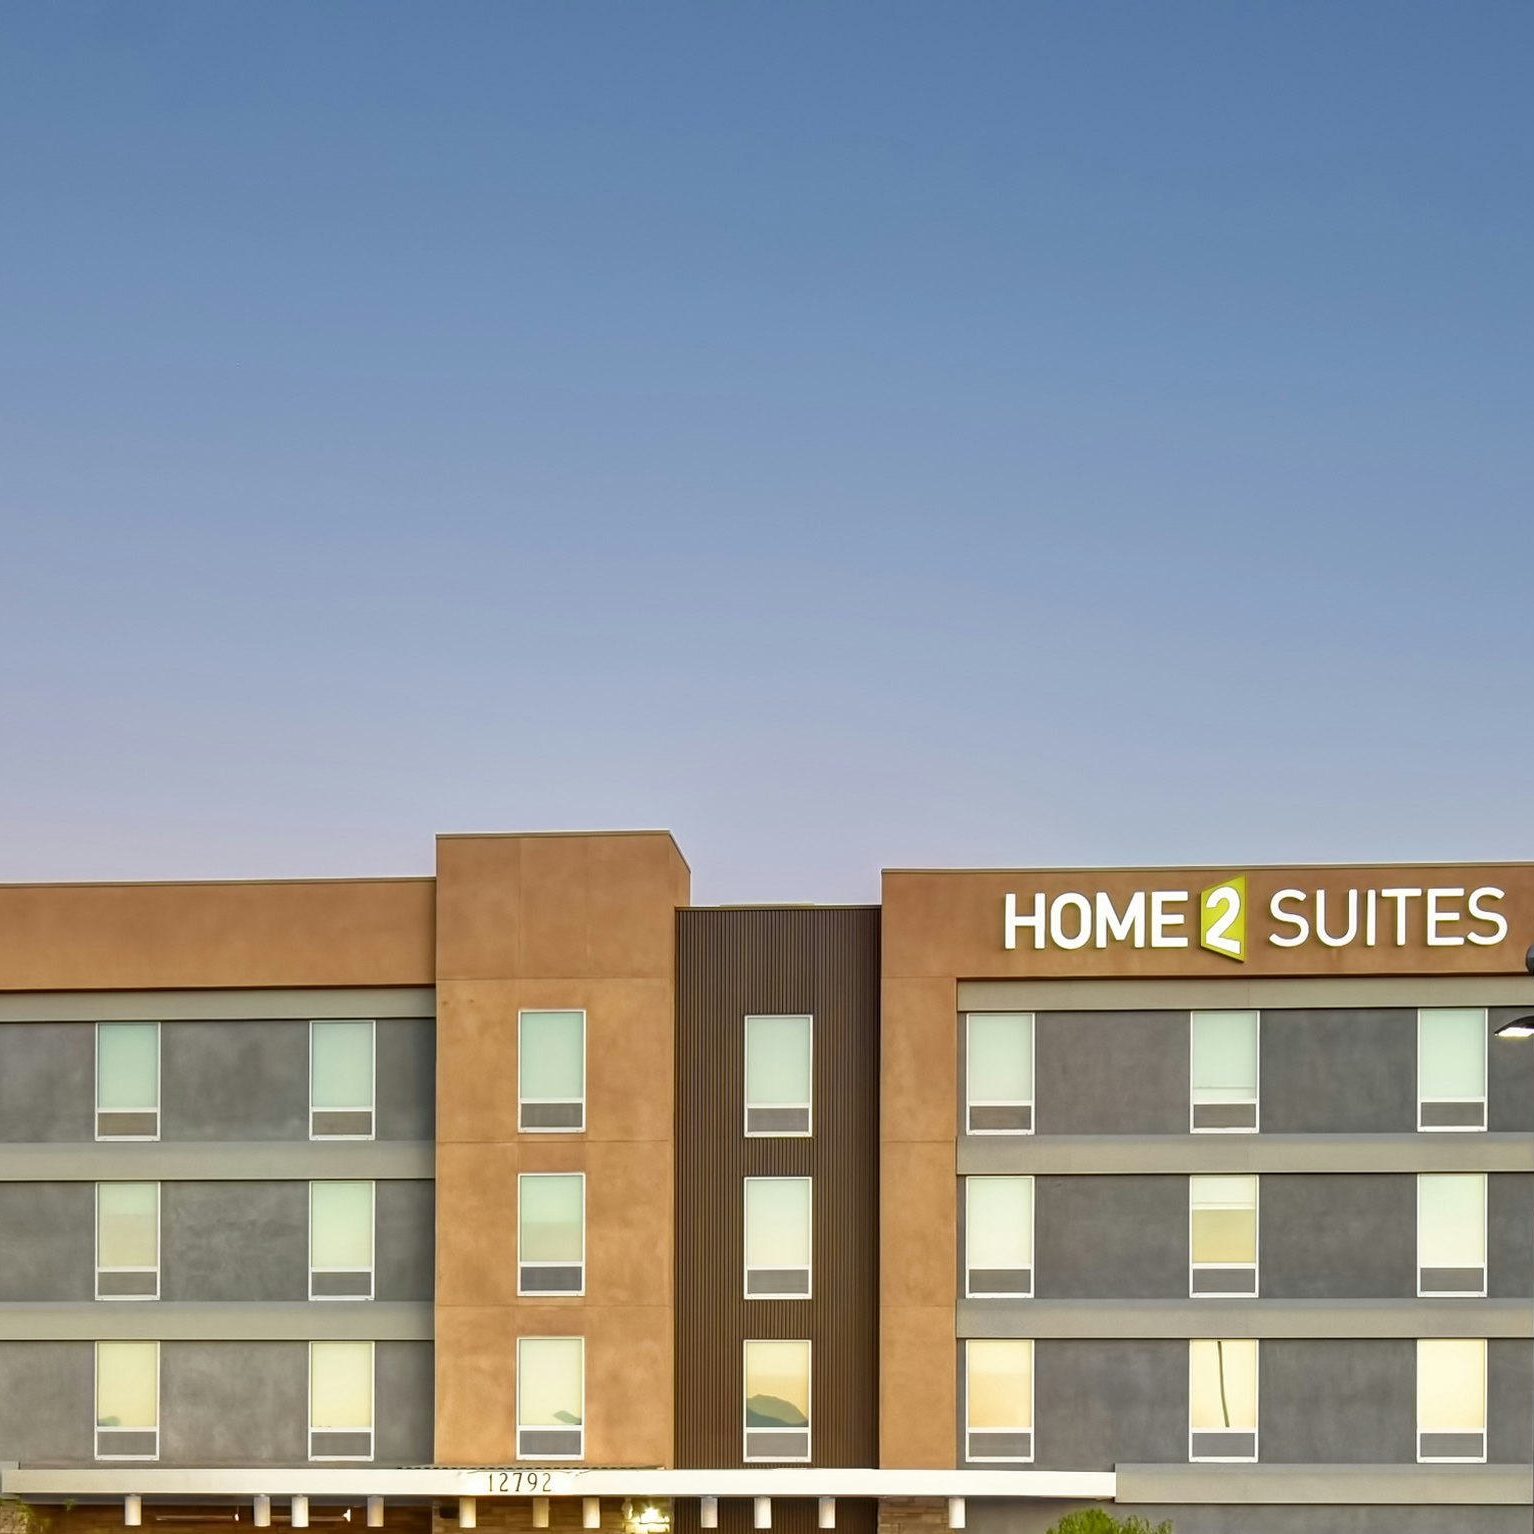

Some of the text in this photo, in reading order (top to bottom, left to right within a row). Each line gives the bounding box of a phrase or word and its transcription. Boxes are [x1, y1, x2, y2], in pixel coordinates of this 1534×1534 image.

[1004, 886, 1508, 955] HOME 2 SUITES
[489, 1472, 552, 1492] 12792
